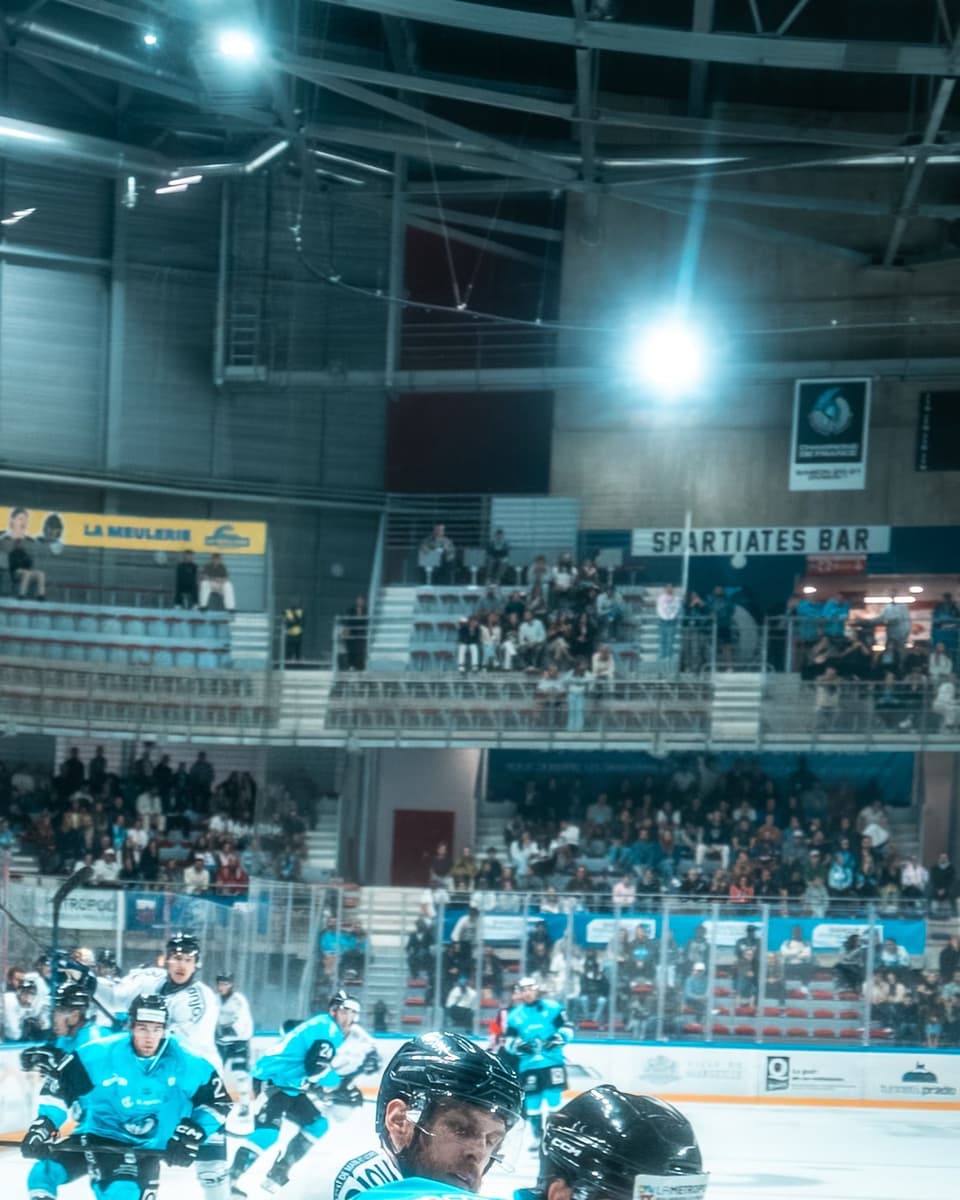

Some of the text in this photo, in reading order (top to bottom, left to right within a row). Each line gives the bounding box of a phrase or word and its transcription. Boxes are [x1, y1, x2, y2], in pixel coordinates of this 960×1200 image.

[84, 524, 103, 537] LA
[107, 525, 192, 542] MEULERIE
[652, 528, 870, 553] SPARTIATES BAR
[551, 1137, 583, 1157] CCM
